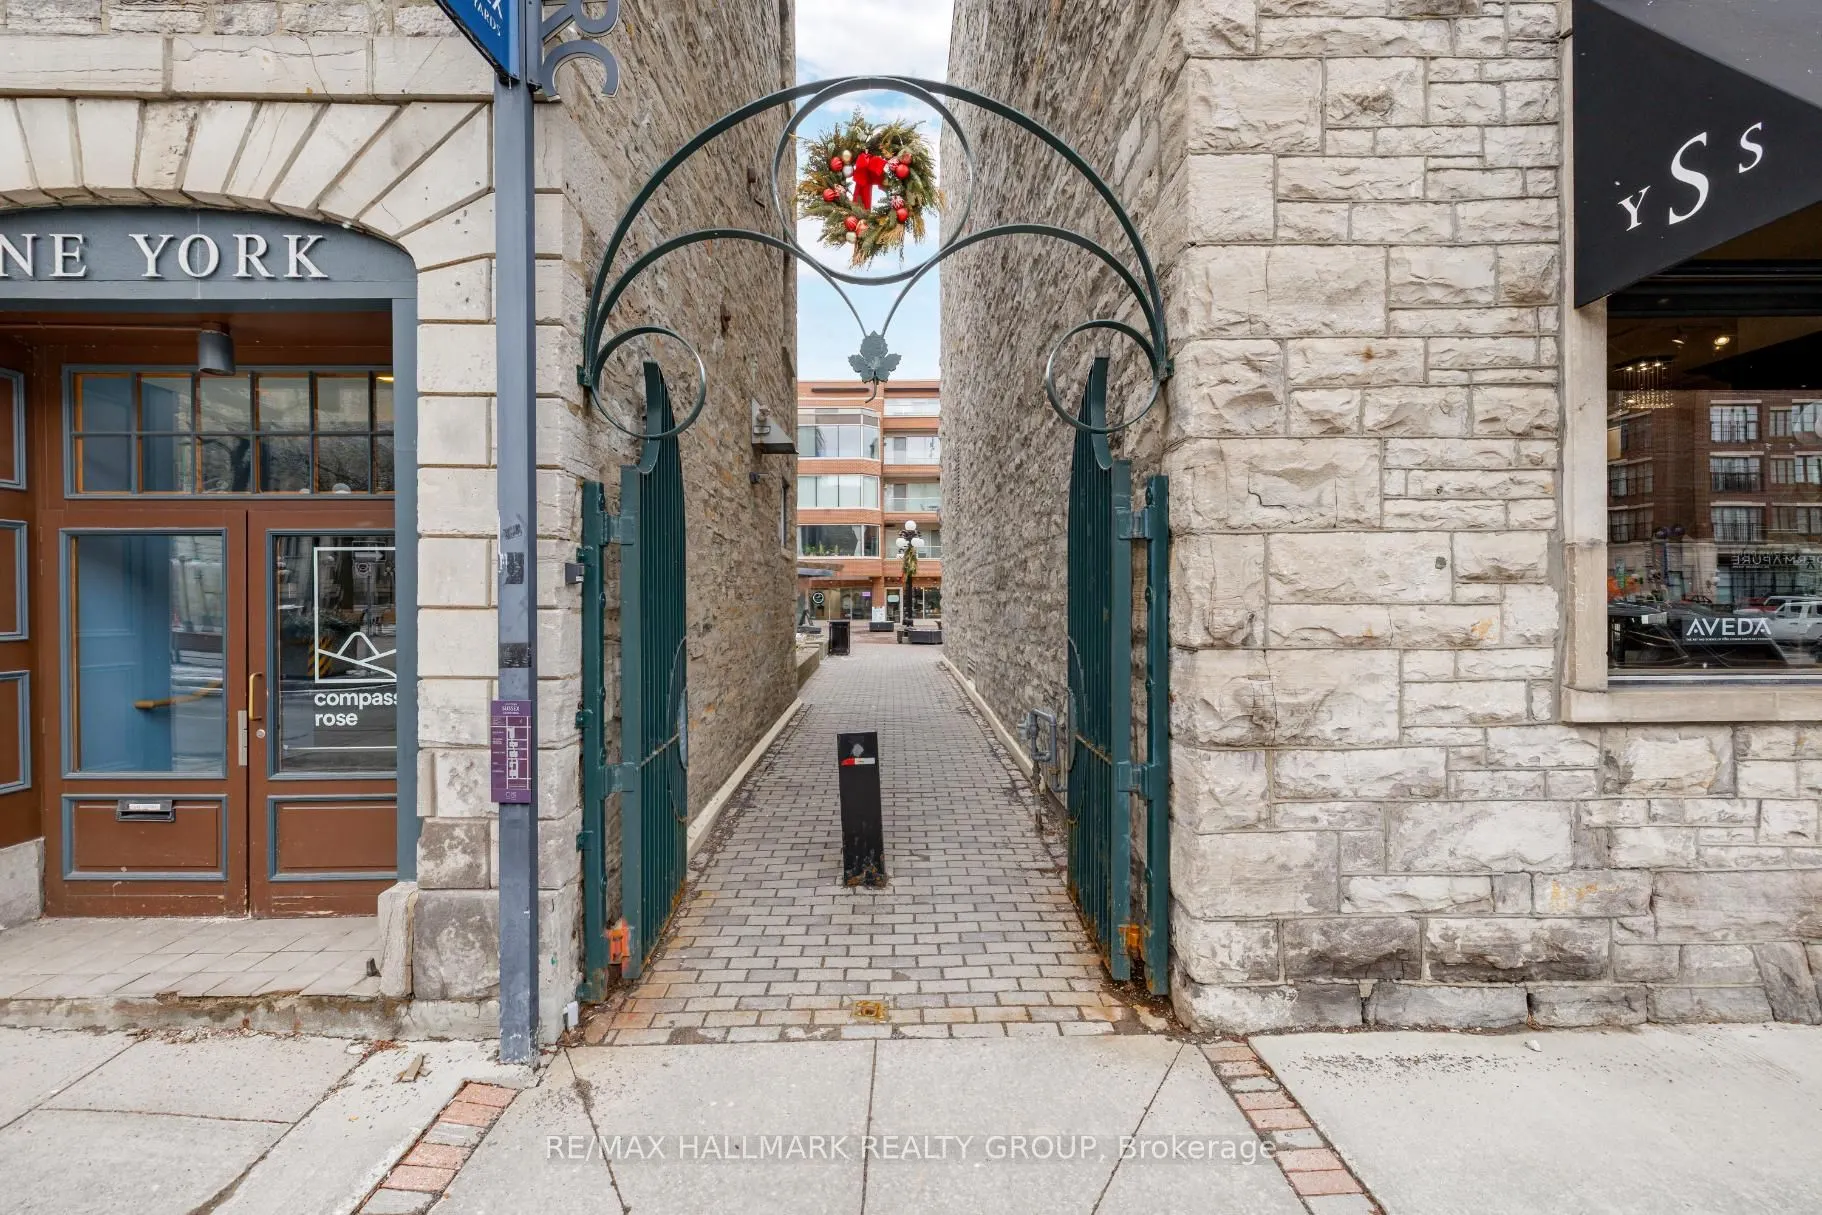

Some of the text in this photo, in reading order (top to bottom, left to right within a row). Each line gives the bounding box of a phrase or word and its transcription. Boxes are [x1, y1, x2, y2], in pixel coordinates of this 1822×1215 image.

[0, 233, 329, 278] NE YORK
[1686, 617, 1772, 636] AVEDA
[315, 712, 358, 727] rose
